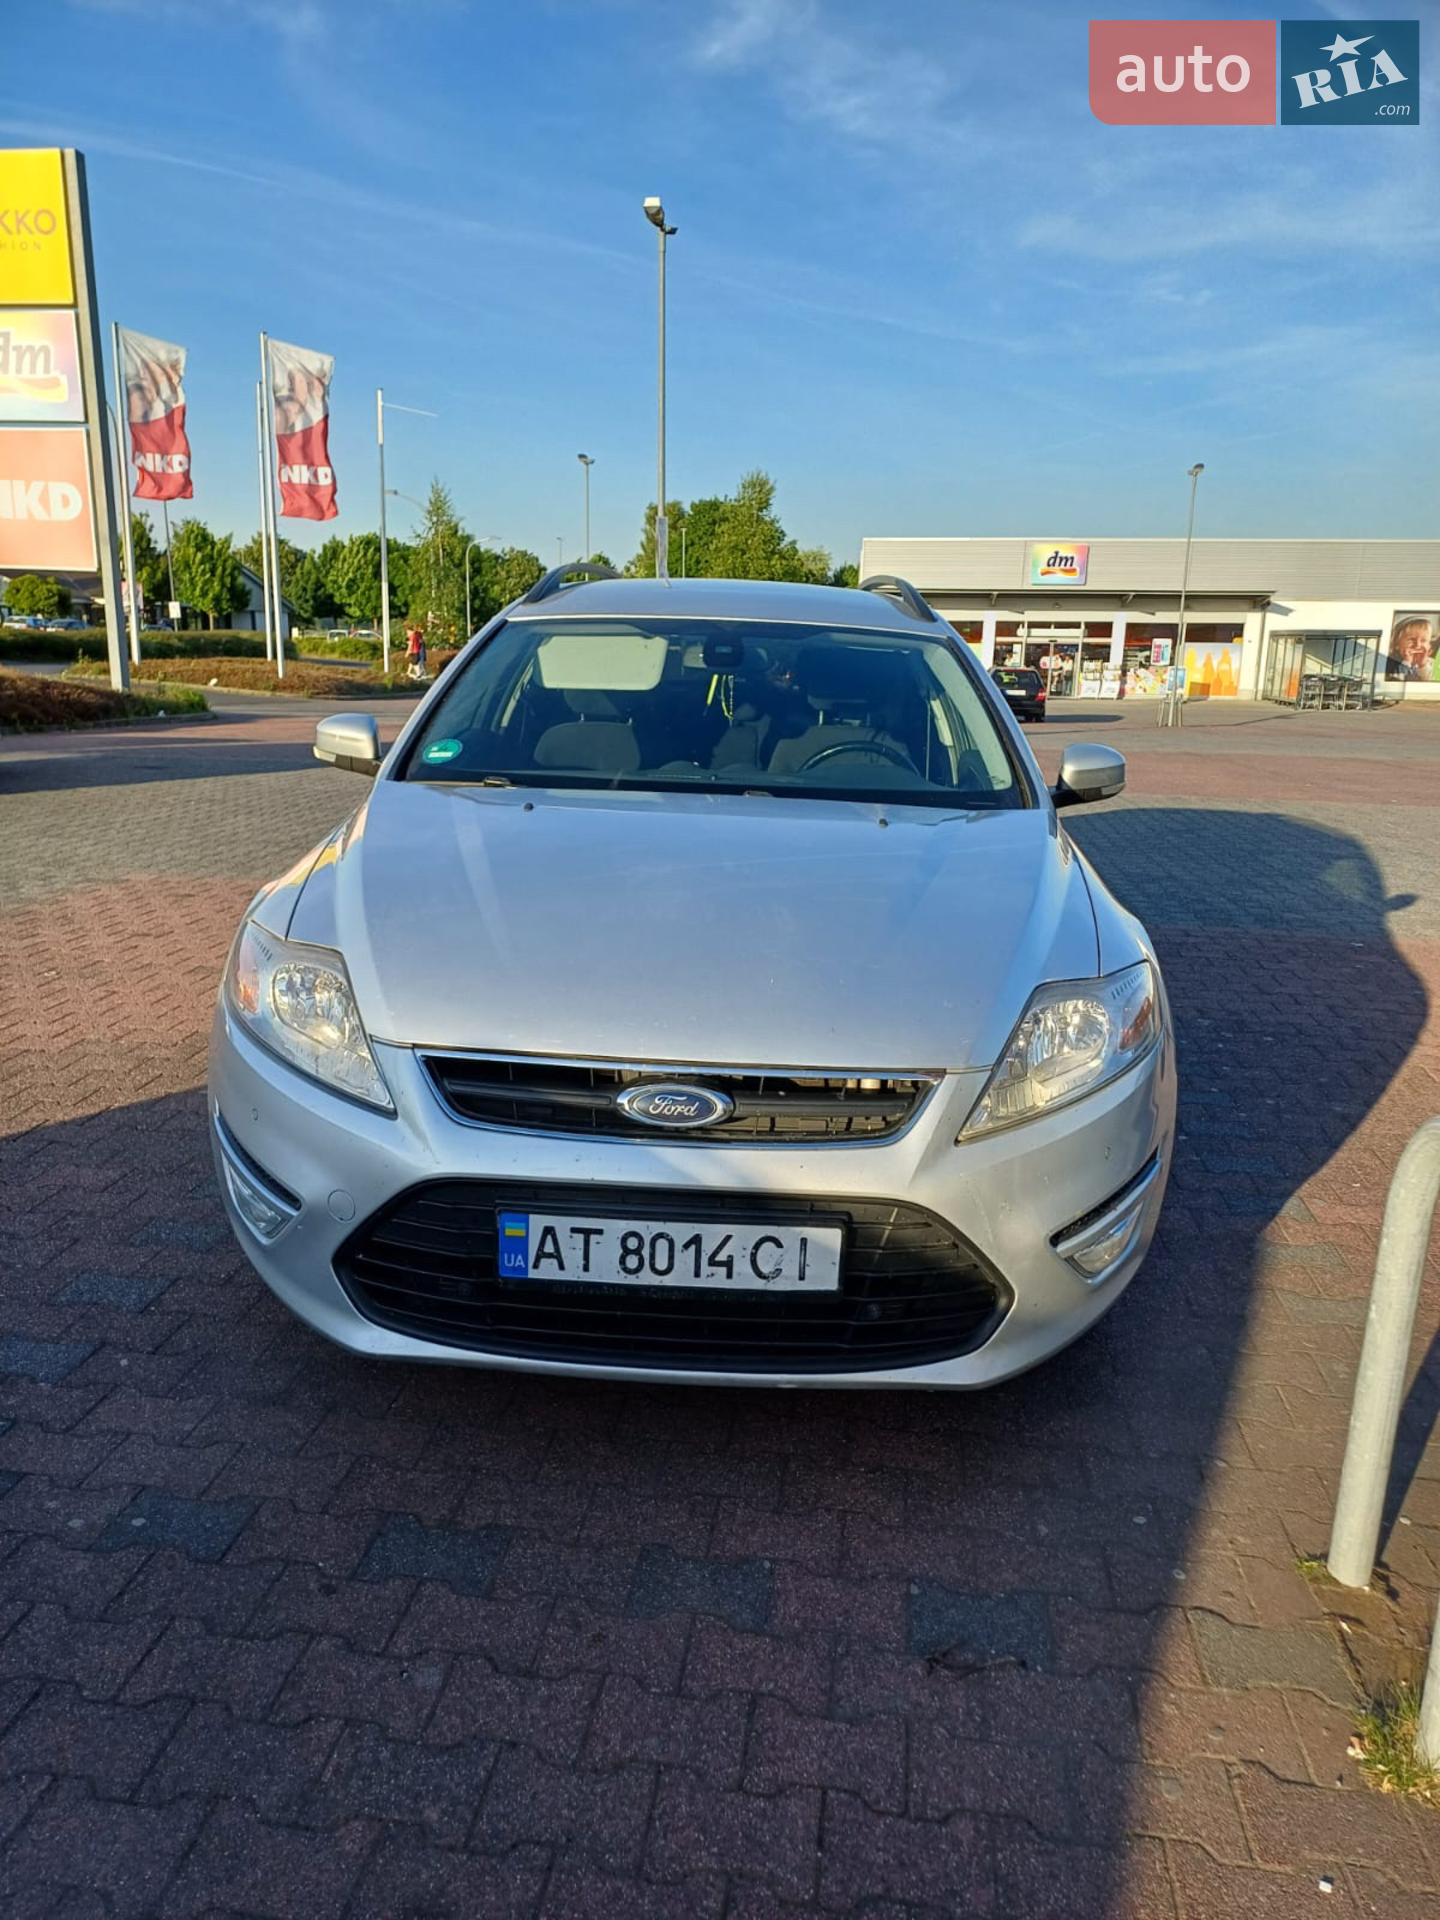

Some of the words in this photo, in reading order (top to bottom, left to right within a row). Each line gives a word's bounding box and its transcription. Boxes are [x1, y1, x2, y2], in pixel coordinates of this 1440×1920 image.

[280, 464, 333, 485] NKD
[1046, 551, 1075, 567] dm
[649, 1094, 699, 1116] Ford
[504, 1253, 525, 1268] UA
[531, 1225, 605, 1273] AT
[618, 1230, 735, 1281] 8014
